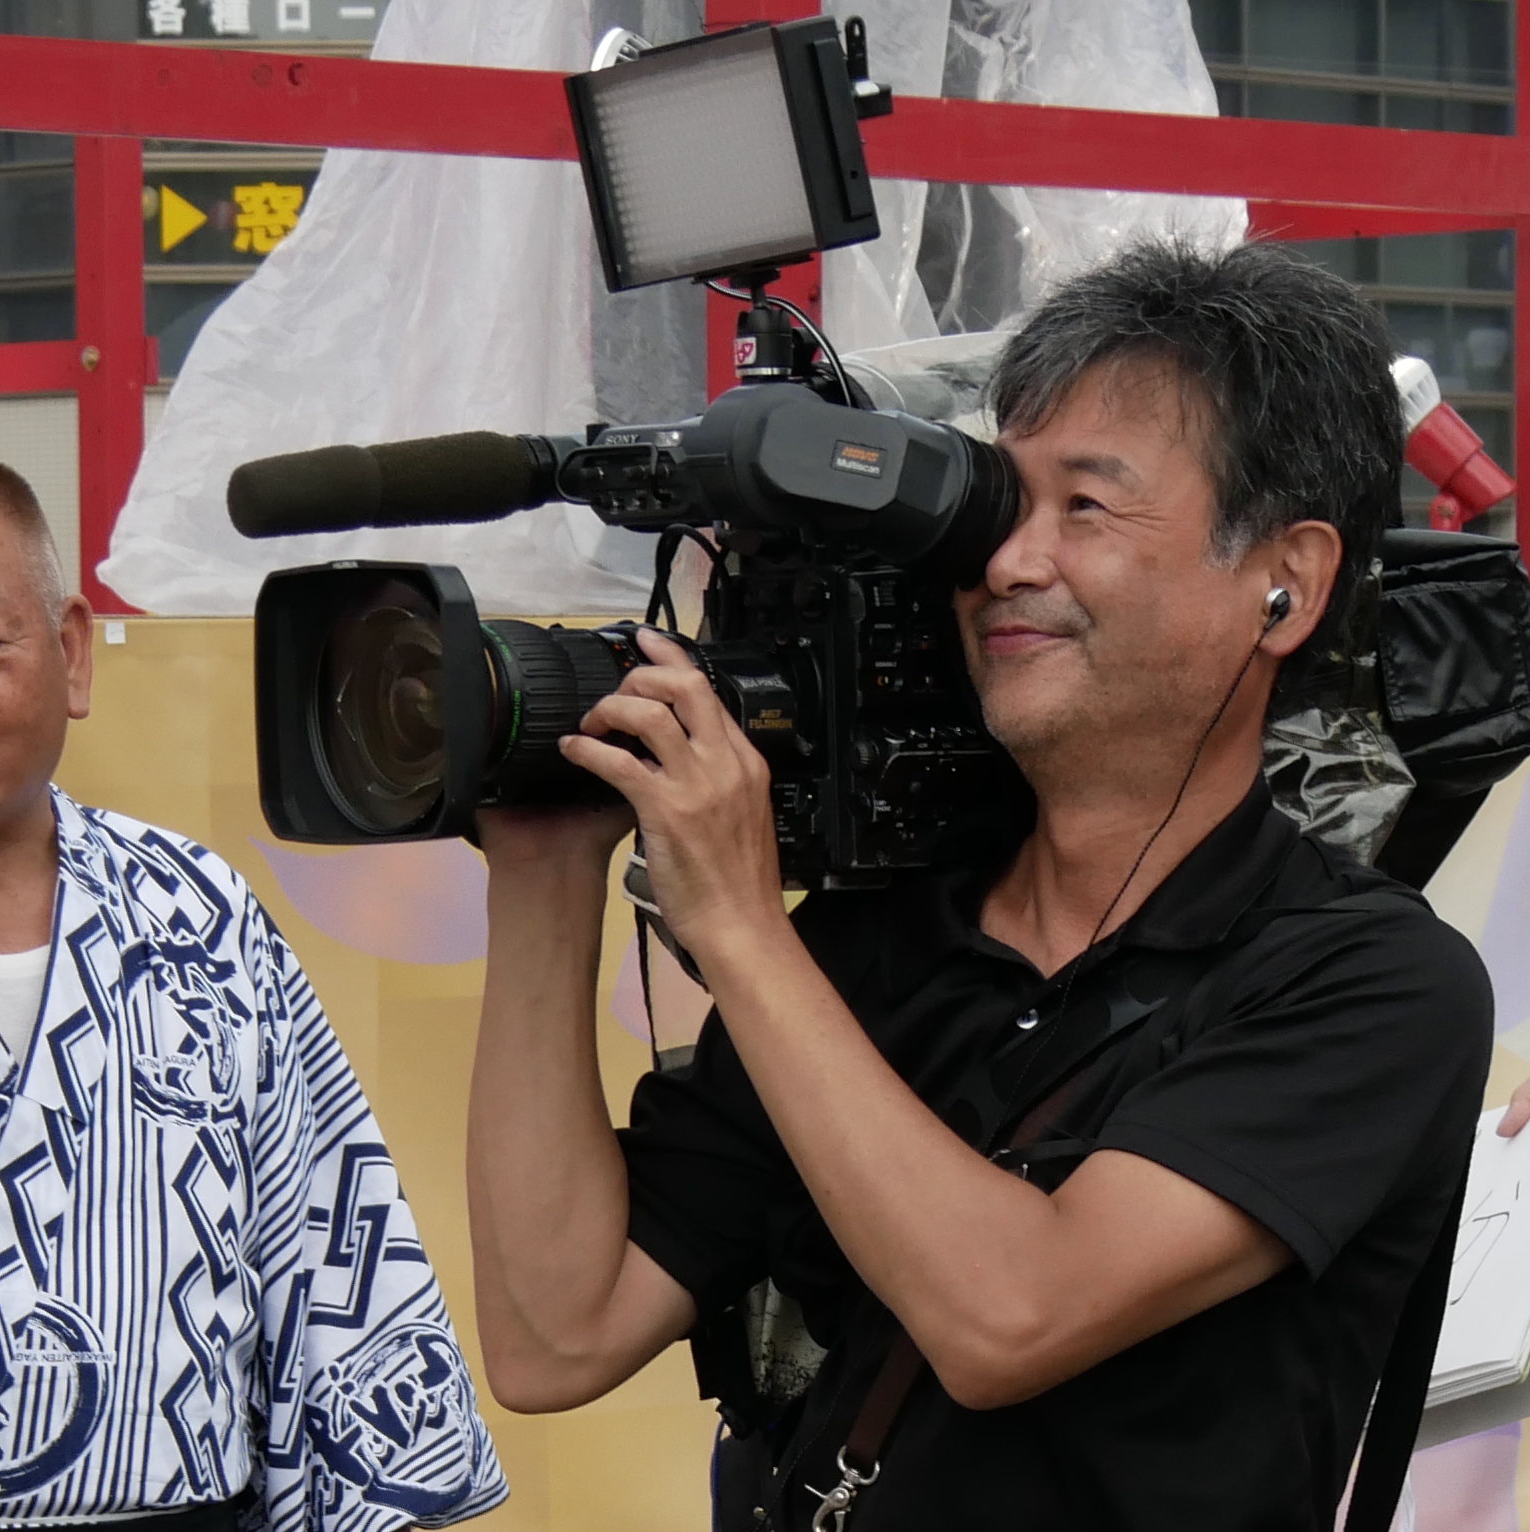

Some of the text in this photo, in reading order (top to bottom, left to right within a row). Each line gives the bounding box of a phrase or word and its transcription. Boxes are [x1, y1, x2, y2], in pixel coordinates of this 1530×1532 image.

[232, 181, 304, 254] 窓
[604, 433, 640, 446] SONY
[136, 1055, 197, 1069] AITEN AGURA
